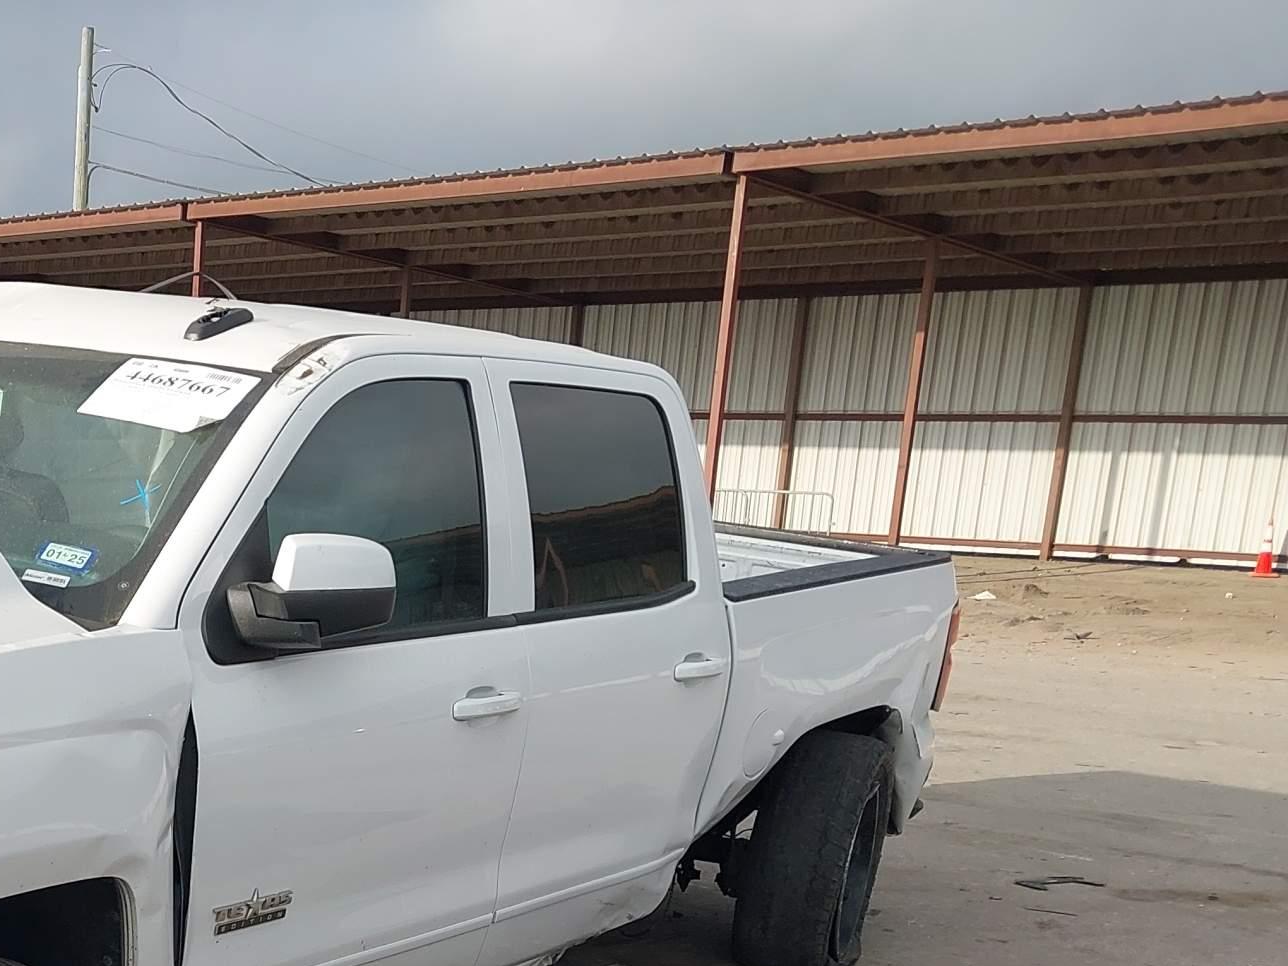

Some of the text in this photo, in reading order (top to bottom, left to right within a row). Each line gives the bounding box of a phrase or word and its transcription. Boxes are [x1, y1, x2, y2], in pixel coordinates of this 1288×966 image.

[126, 370, 231, 397] 44687667
[46, 548, 63, 560] 01
[67, 554, 87, 565] 25
[213, 889, 293, 922] TEXAS
[220, 911, 284, 932] EDITION
